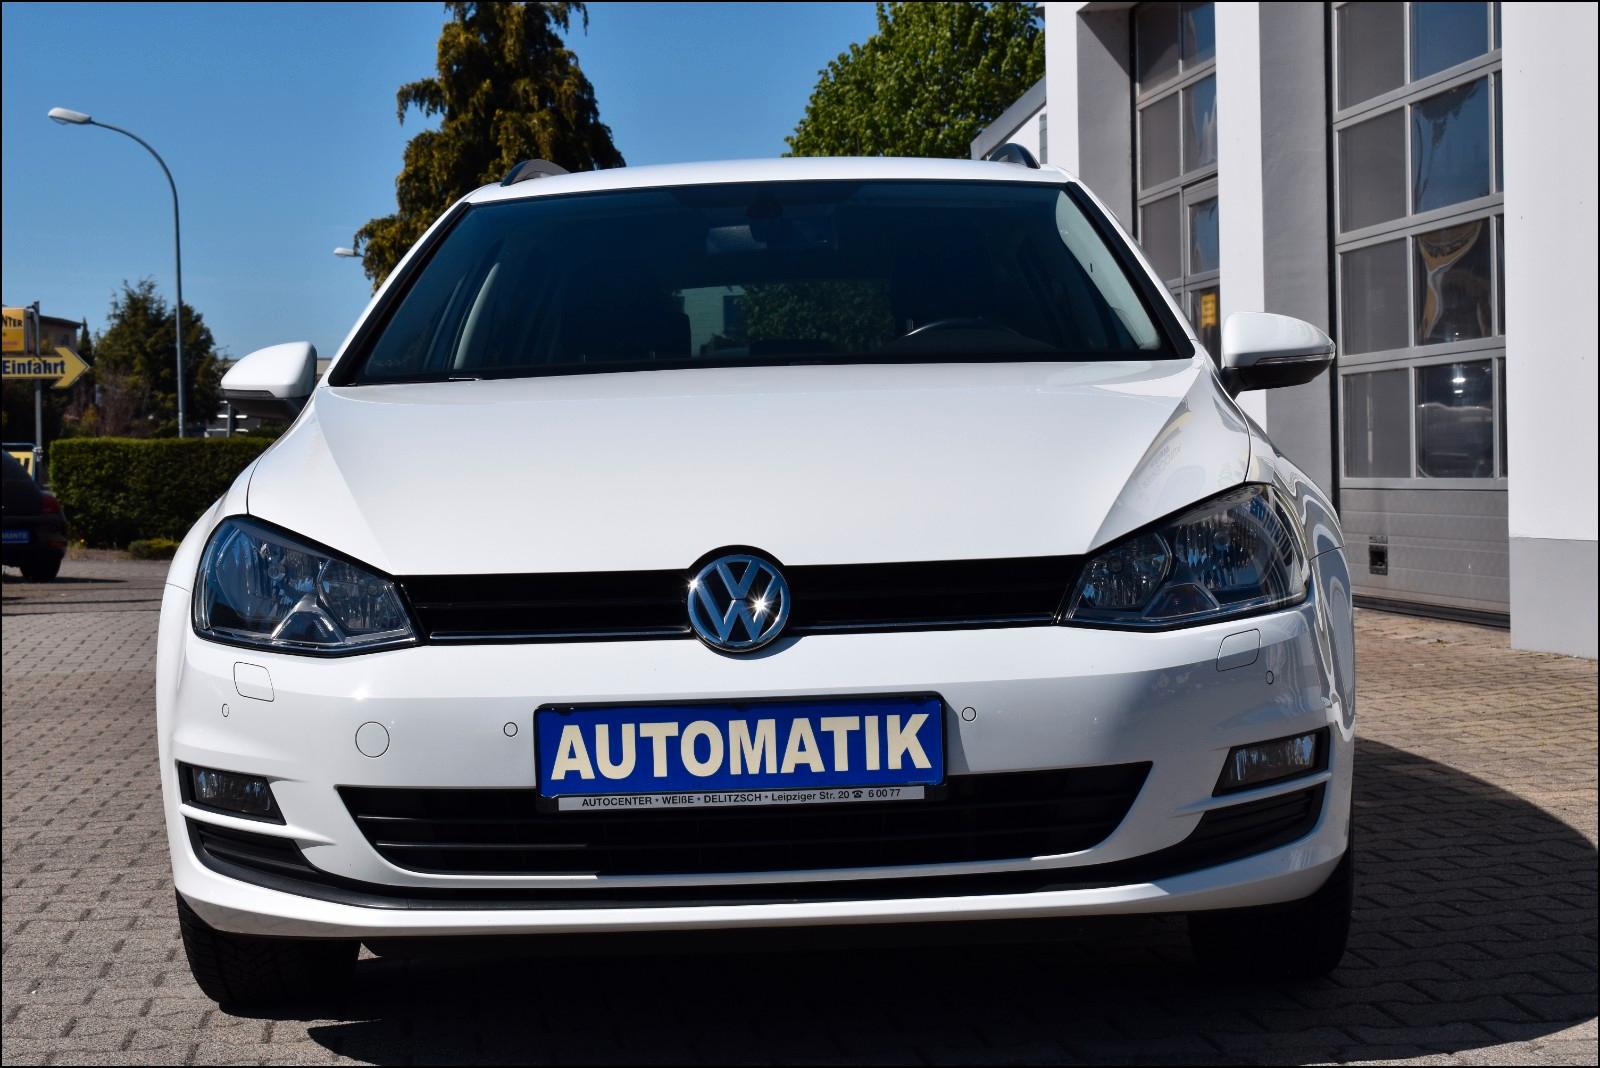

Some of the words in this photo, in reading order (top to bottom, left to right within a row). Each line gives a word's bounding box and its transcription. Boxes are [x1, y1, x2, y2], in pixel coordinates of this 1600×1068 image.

[2, 360, 65, 375] Einfahrt
[551, 713, 932, 781] AUTOMATIK
[582, 796, 652, 807] AUTOCENTER
[704, 793, 762, 803] DELITZSCH
[771, 792, 817, 802] Leipziger
[819, 791, 836, 800] Str.
[838, 790, 850, 799] 20
